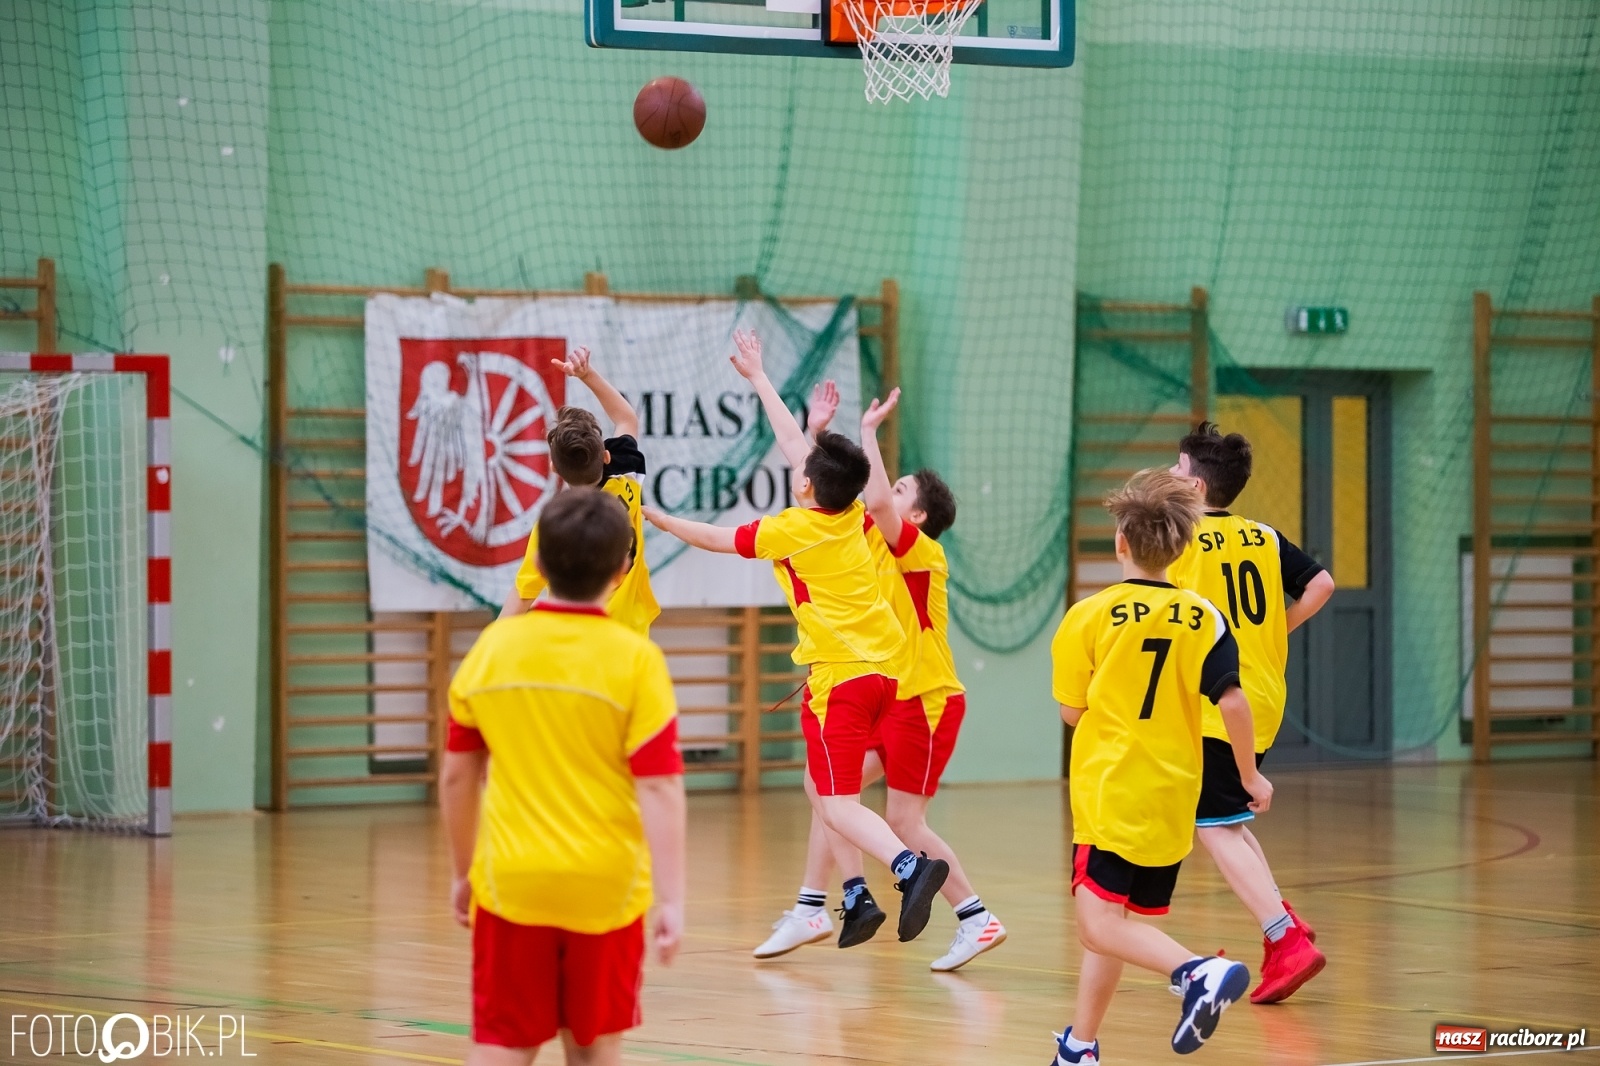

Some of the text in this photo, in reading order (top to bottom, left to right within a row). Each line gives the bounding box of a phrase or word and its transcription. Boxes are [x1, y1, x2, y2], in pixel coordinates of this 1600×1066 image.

[1198, 528, 1266, 552] SP 13
[1110, 602, 1204, 631] SP 13
[1221, 560, 1266, 629] 10
[1138, 638, 1172, 719] 7
